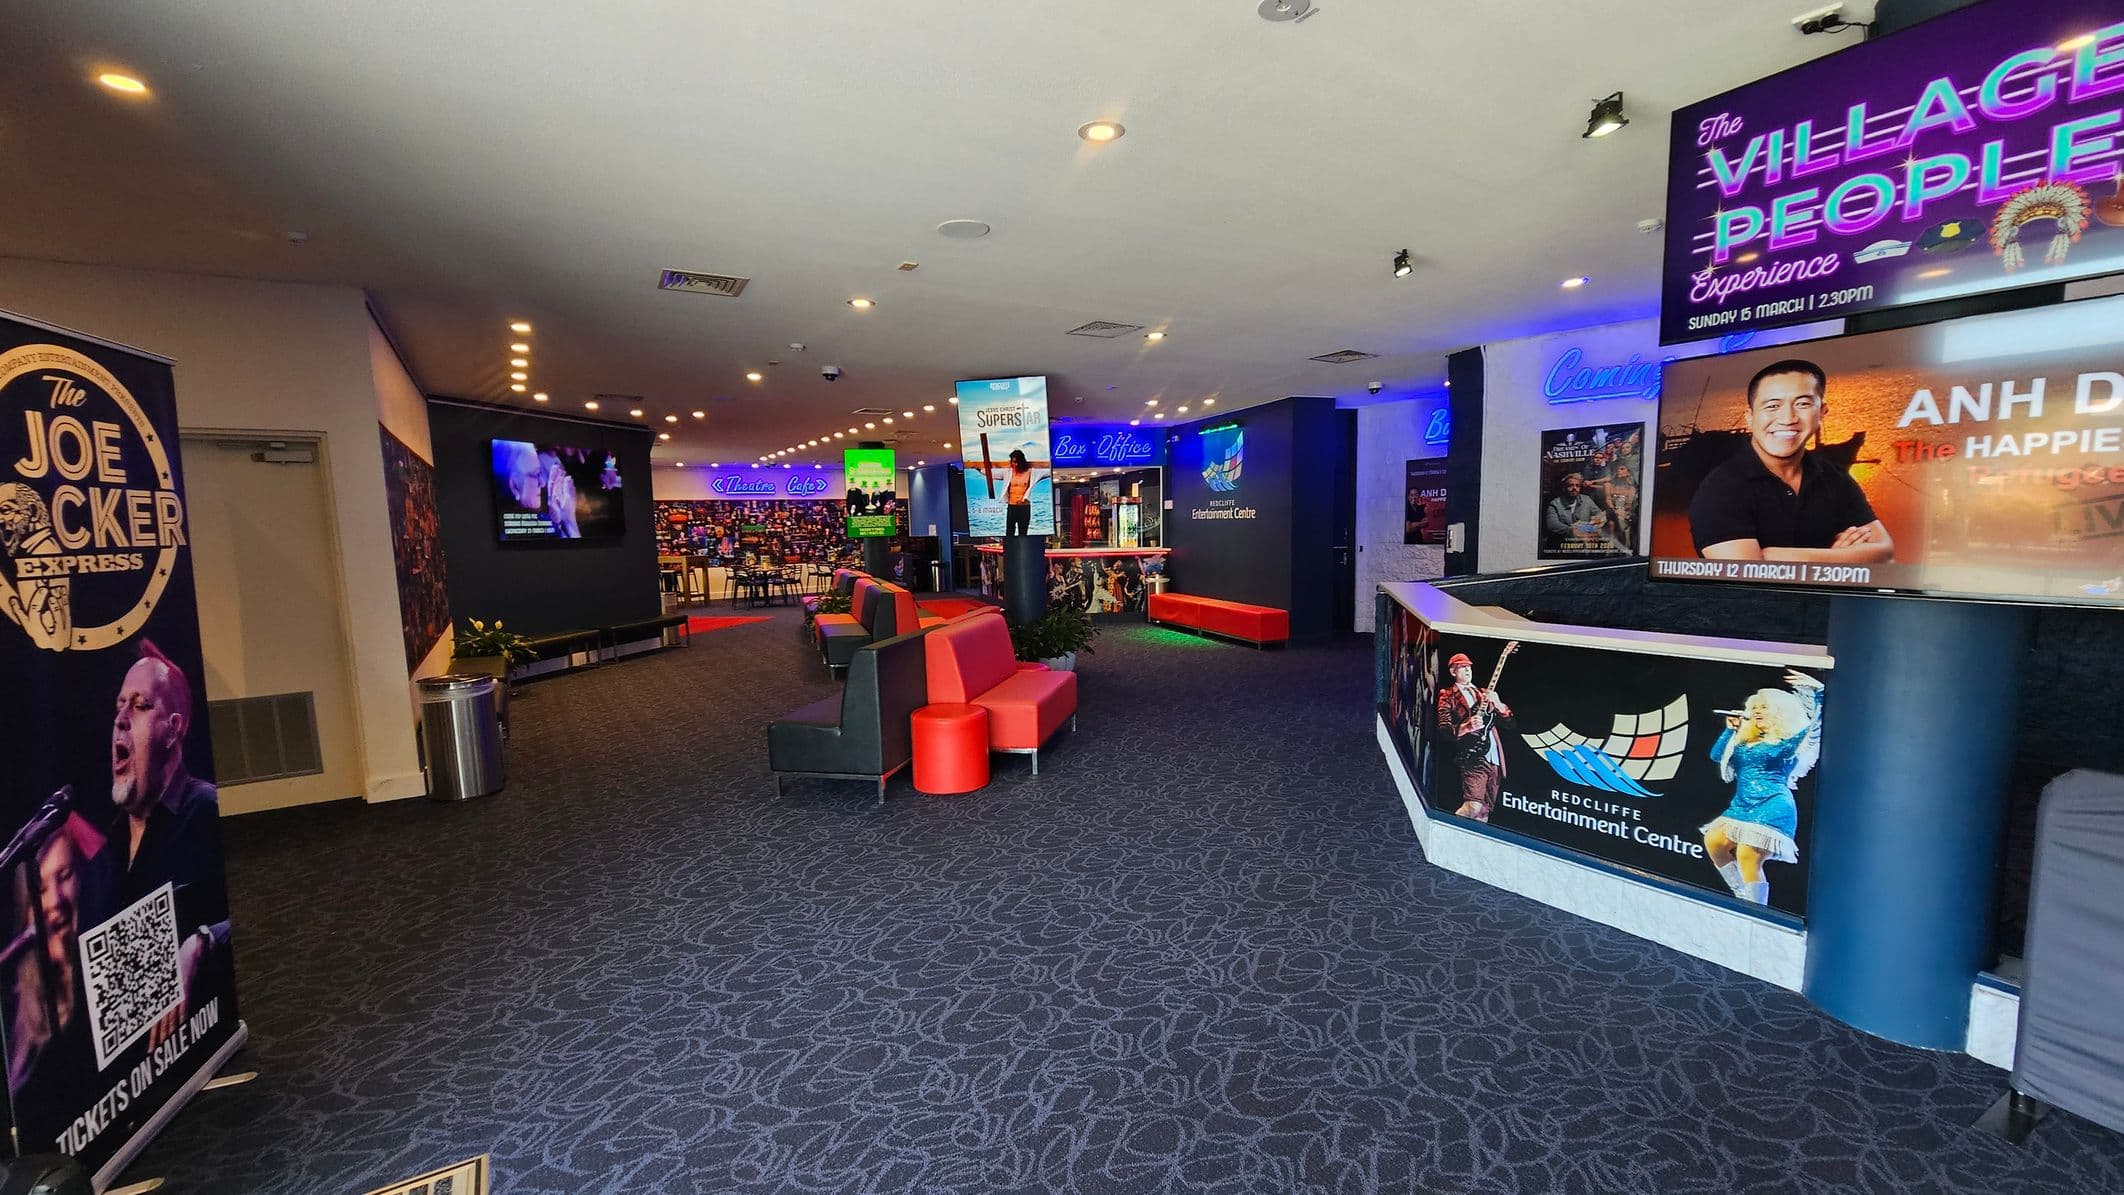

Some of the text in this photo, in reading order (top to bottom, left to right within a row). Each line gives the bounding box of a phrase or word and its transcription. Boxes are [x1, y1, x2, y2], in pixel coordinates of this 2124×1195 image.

[1707, 22, 2124, 197] VILLAGE
[1697, 112, 1744, 146] The
[1713, 108, 2123, 263] PEOPLE
[1690, 253, 1841, 304] Experience
[1688, 285, 1874, 330] SUNDAY 15 MARCH 2.30PM
[42, 374, 87, 409] The
[1896, 371, 2124, 428] ANH D
[14, 410, 127, 484] JOE
[1055, 432, 1152, 462] Box Office
[1894, 427, 2124, 464] The HAPPIE
[726, 475, 816, 496] Theatre Cafe
[1210, 499, 1235, 507] REDCLIFFE
[1420, 489, 1438, 498] ANH
[1192, 506, 1257, 520] Entertainment Centre
[15, 553, 144, 578] EXPRESS
[1657, 560, 1870, 583] THURSDAY 12 MARCH 7.30PM
[1551, 789, 1642, 821] REDCLIFFE
[1502, 791, 1704, 859] Entertainment Centre
[55, 996, 219, 1157] TICKETS ON SALE NOW
